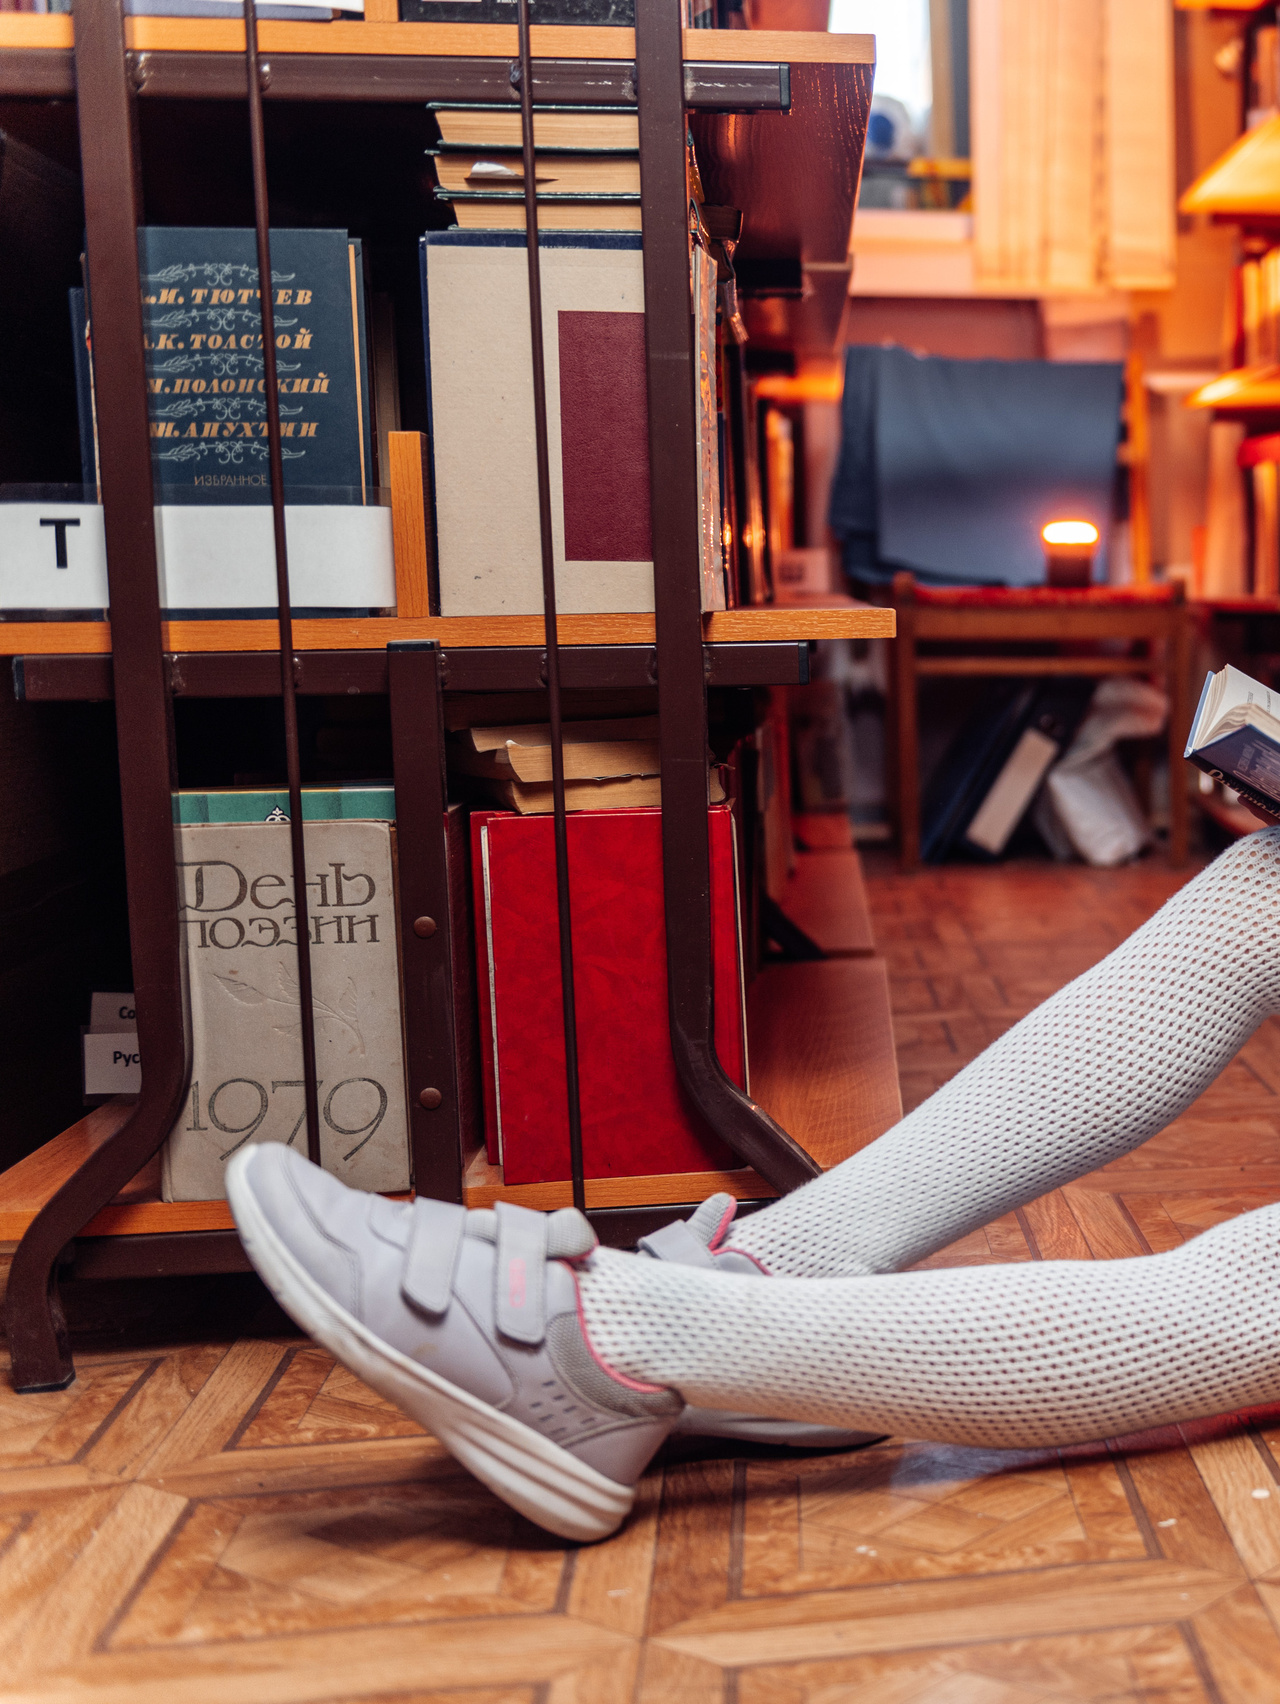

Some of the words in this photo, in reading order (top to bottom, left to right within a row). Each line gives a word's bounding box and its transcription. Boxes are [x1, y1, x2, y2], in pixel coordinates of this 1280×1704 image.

[194, 475, 268, 487] ИЗБРАННОЕ
[39, 518, 80, 569] Т
[186, 1077, 388, 1162] 1979
